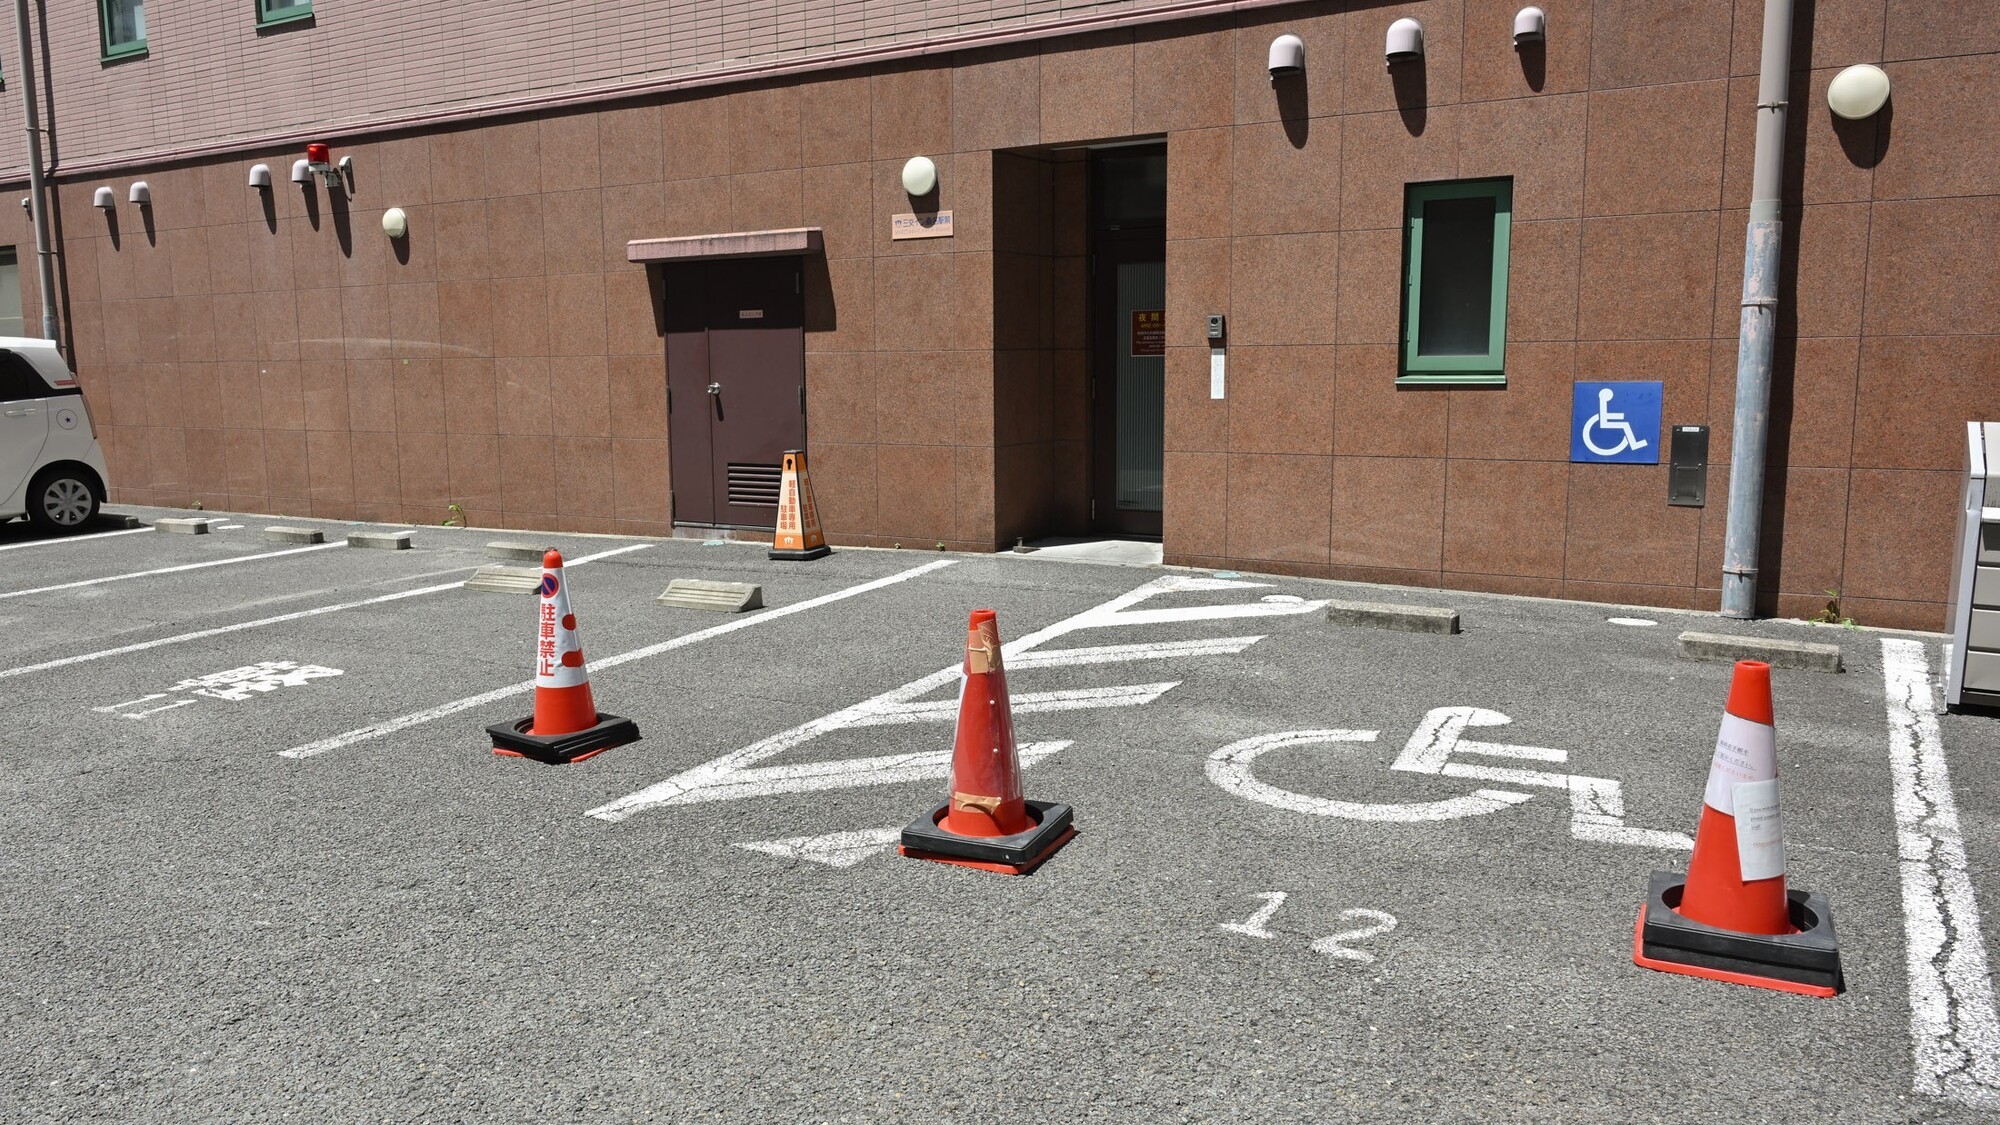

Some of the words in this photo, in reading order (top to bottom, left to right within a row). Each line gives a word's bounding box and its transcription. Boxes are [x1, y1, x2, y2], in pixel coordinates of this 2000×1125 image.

[539, 603, 555, 677] 駐車禁止
[1220, 891, 1398, 963] 12
